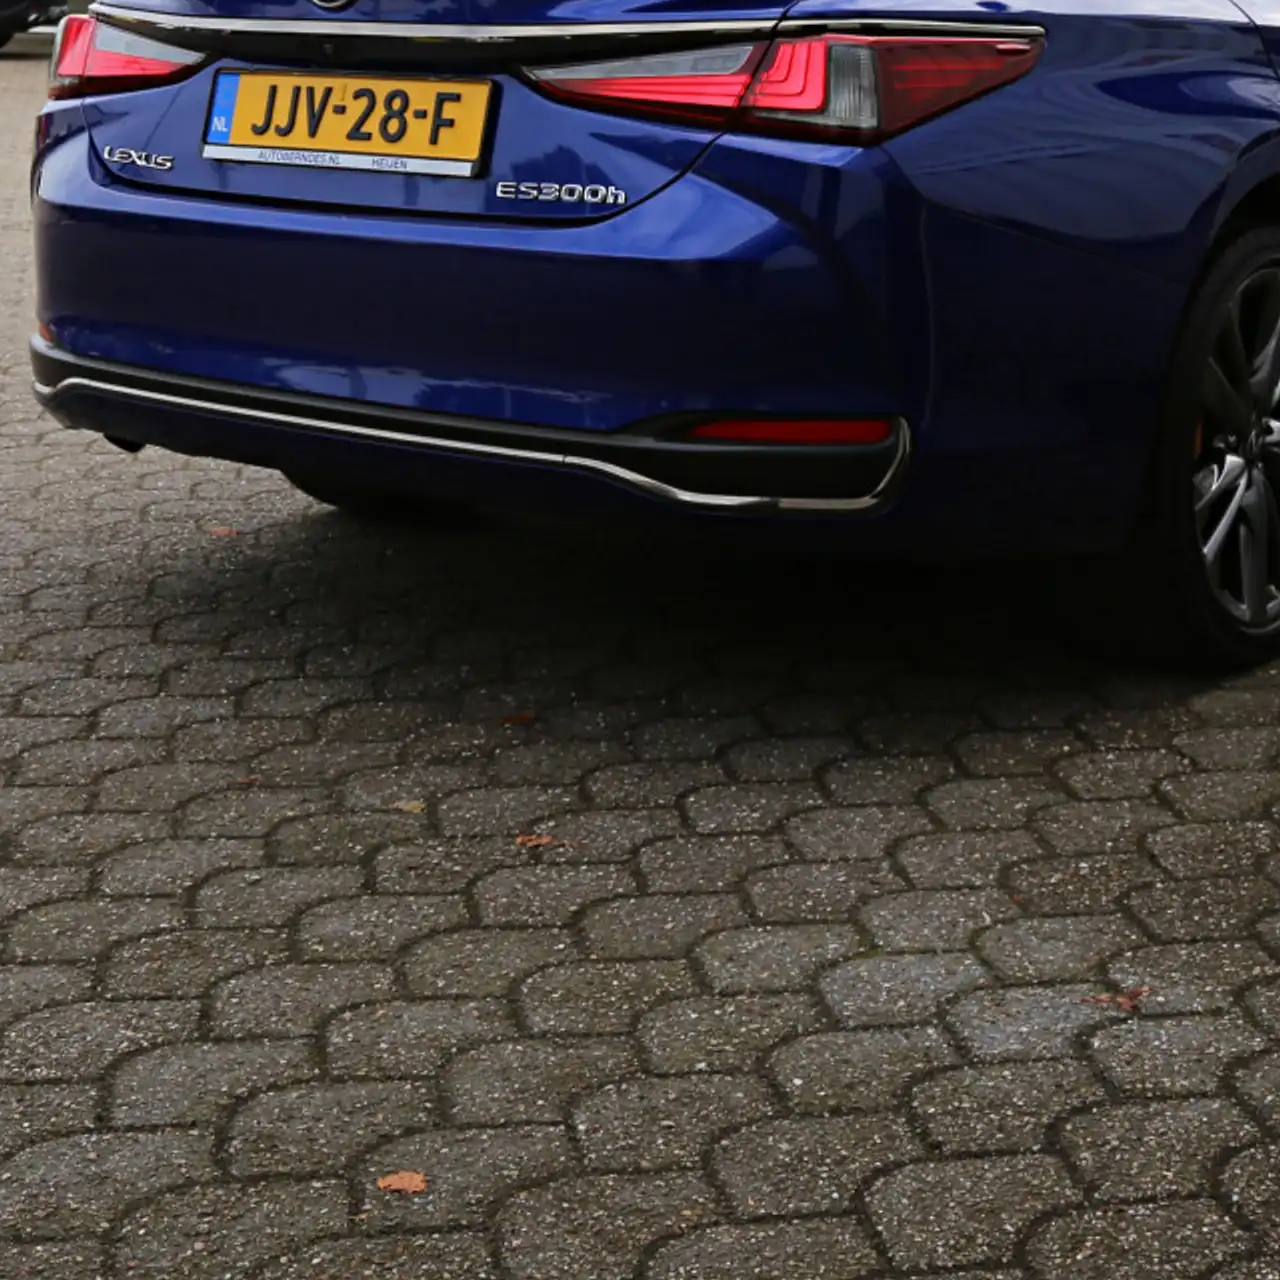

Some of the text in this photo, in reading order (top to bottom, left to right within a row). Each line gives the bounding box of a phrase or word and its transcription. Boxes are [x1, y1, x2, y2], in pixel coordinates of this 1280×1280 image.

[211, 83, 462, 146] NL JJV-28-F
[103, 144, 174, 171] LEXUS
[495, 180, 627, 205] ES300h
